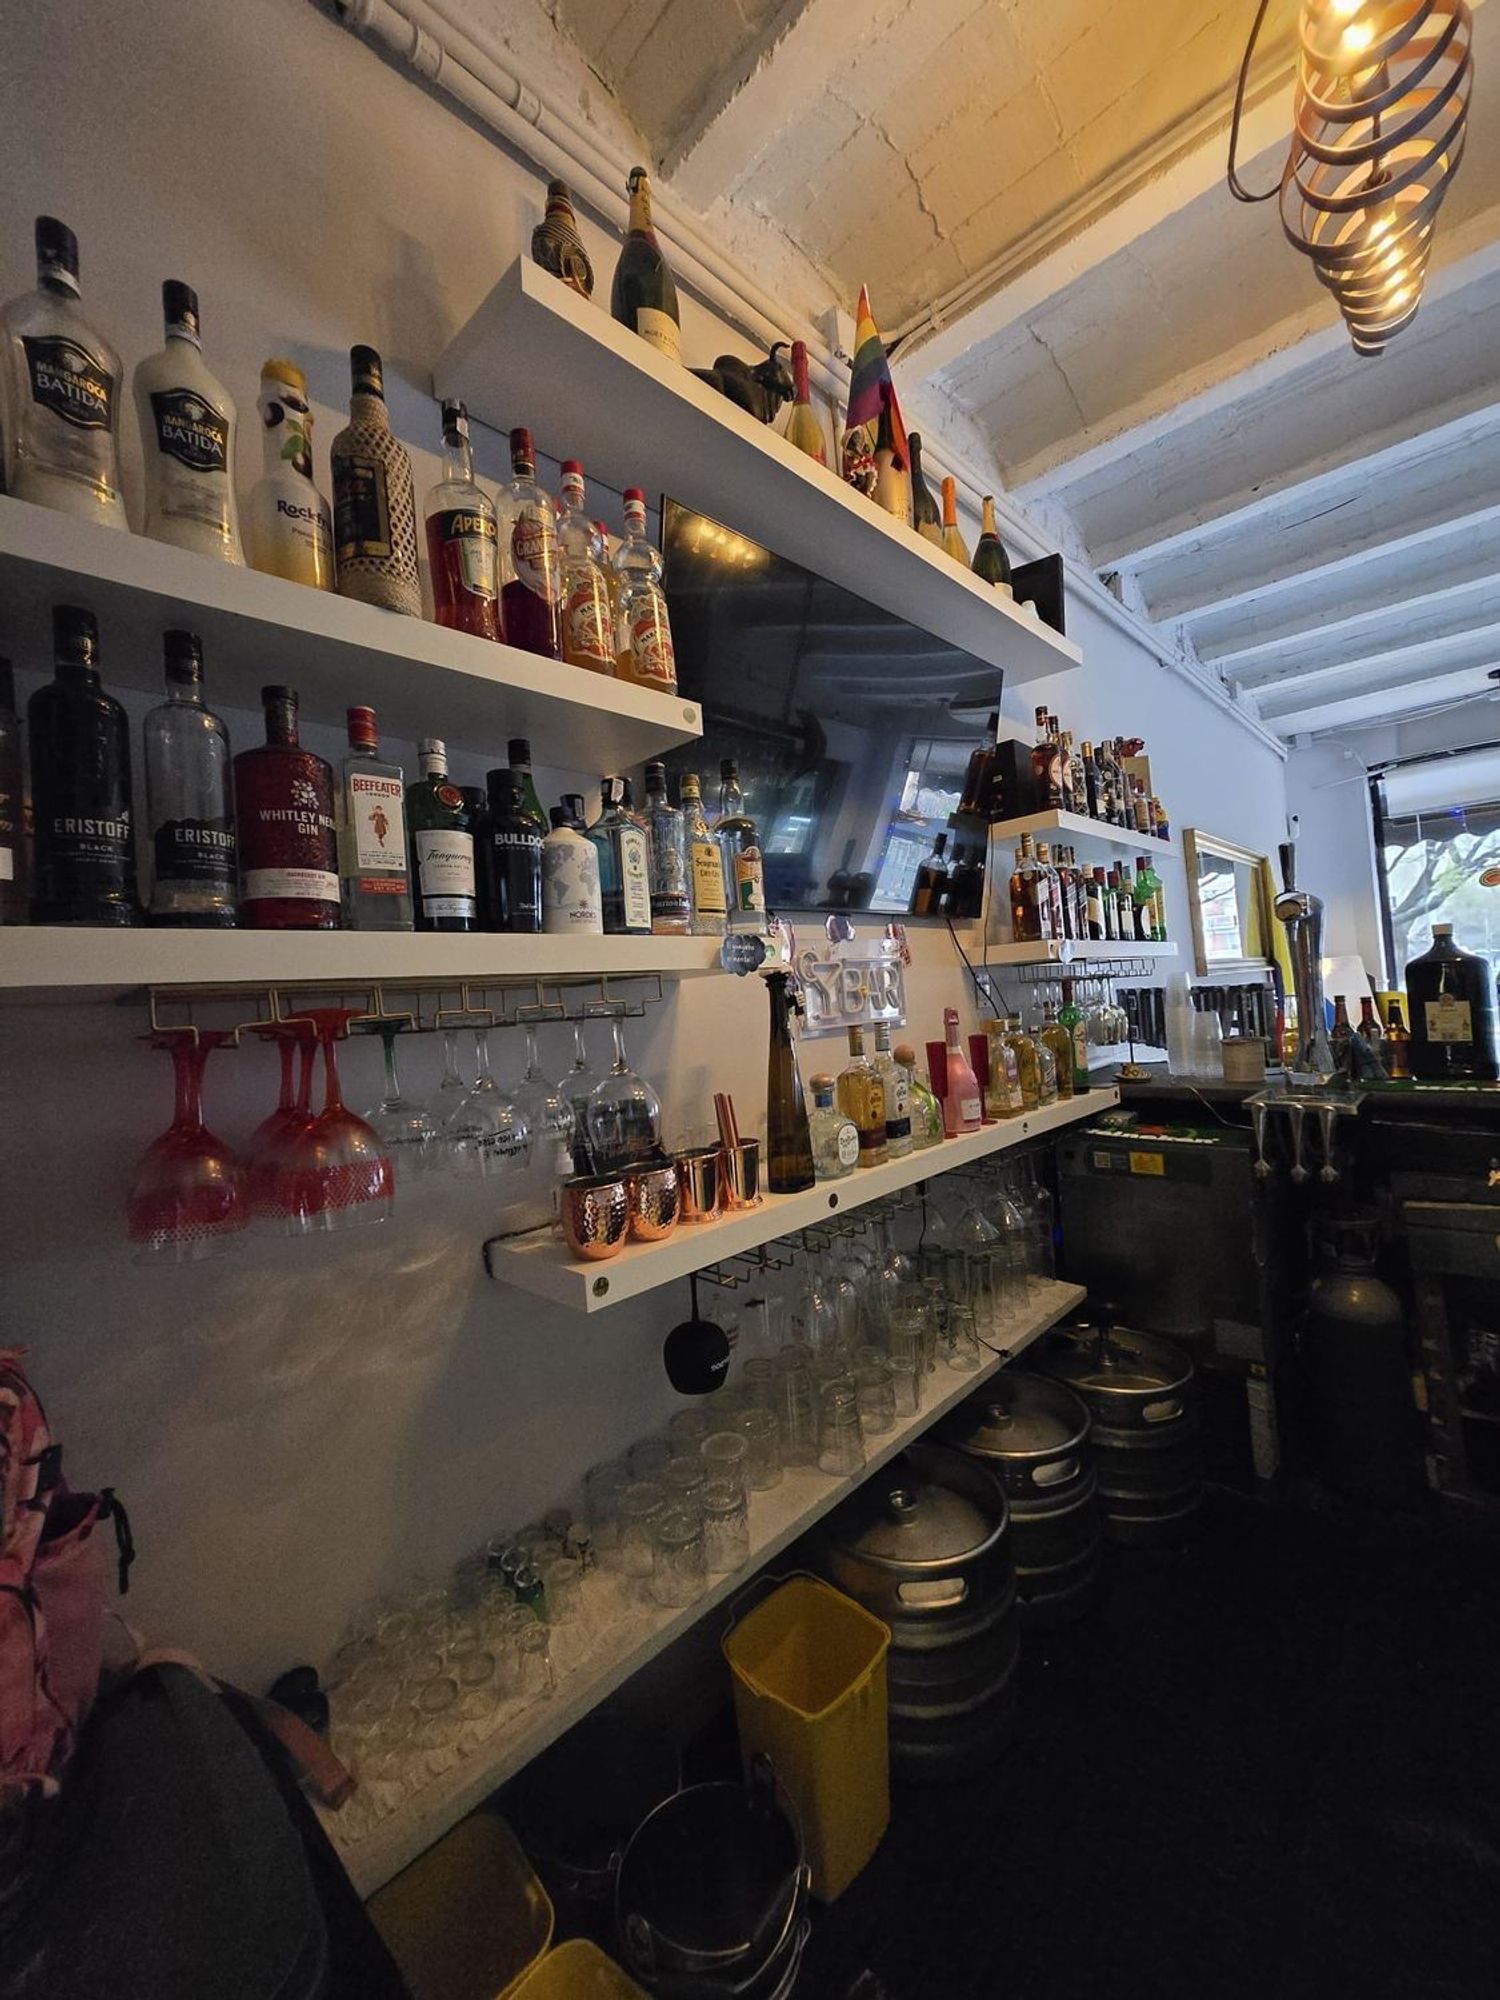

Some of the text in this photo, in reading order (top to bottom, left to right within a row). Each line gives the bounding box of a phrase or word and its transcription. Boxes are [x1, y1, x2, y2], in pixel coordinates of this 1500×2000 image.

[37, 372, 107, 417] BATIDA
[162, 424, 223, 459] BATIDA
[353, 778, 401, 798] BEEFEATER
[259, 809, 316, 823] WHITLEY
[54, 817, 130, 841] ERISTOFF
[298, 823, 318, 836] GIN
